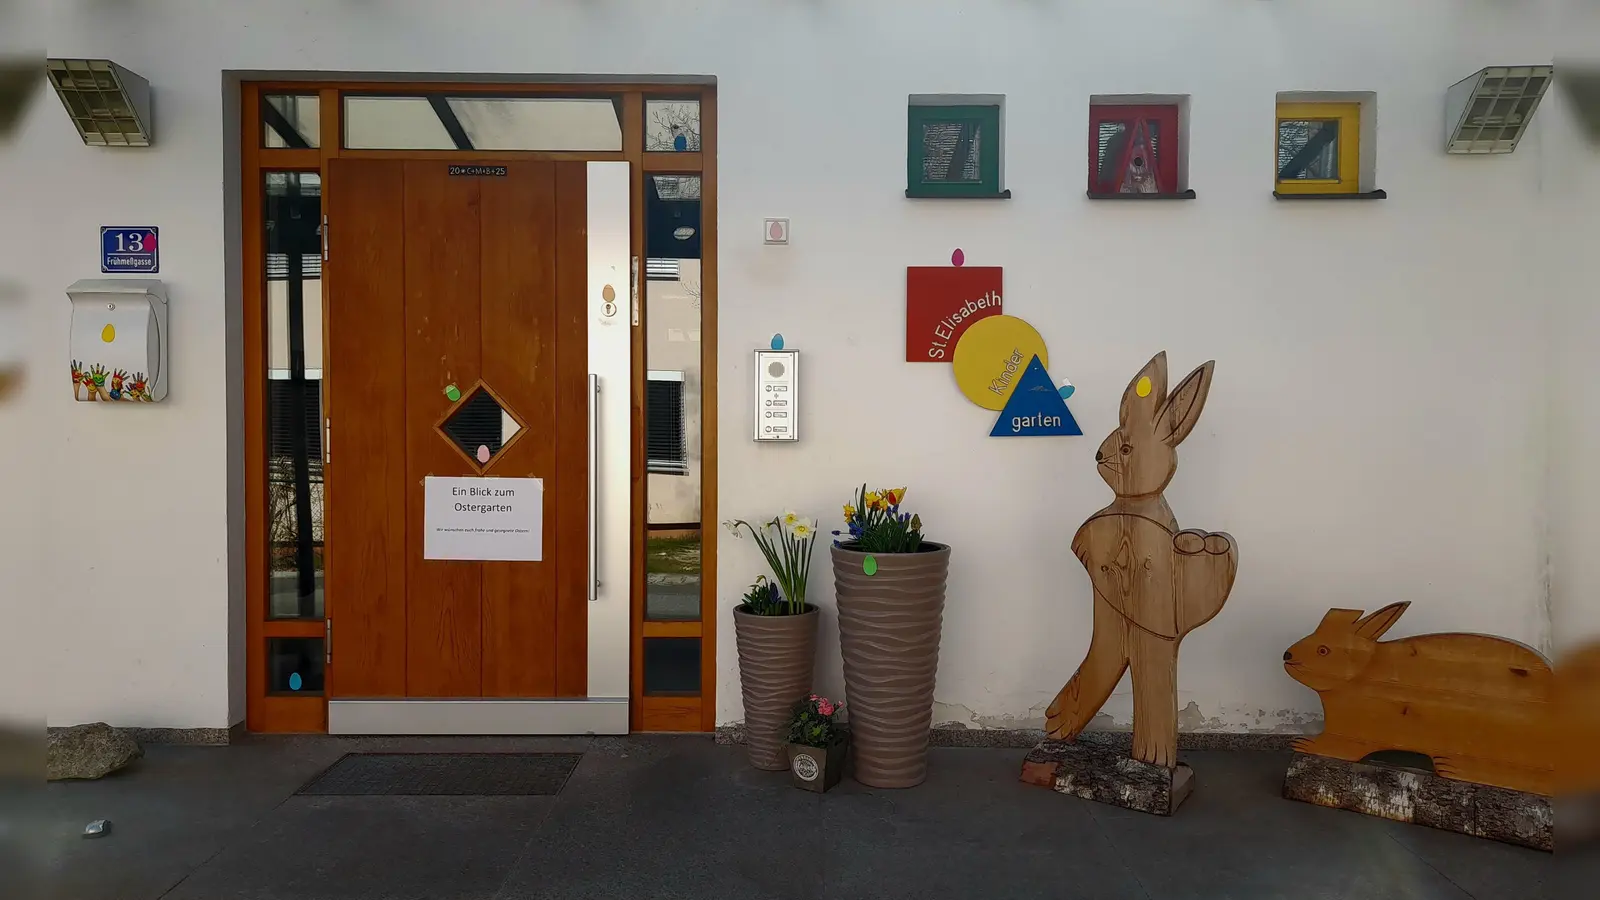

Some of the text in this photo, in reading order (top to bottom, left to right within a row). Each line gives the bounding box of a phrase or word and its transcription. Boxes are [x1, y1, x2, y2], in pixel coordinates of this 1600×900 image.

[115, 233, 143, 251] 13
[934, 290, 1002, 340] Elisabeth
[988, 348, 1024, 396] Kinder
[1012, 412, 1061, 433] garten
[452, 487, 466, 496] Ein
[470, 487, 492, 496] Blick
[454, 502, 512, 513] Ostergarten
